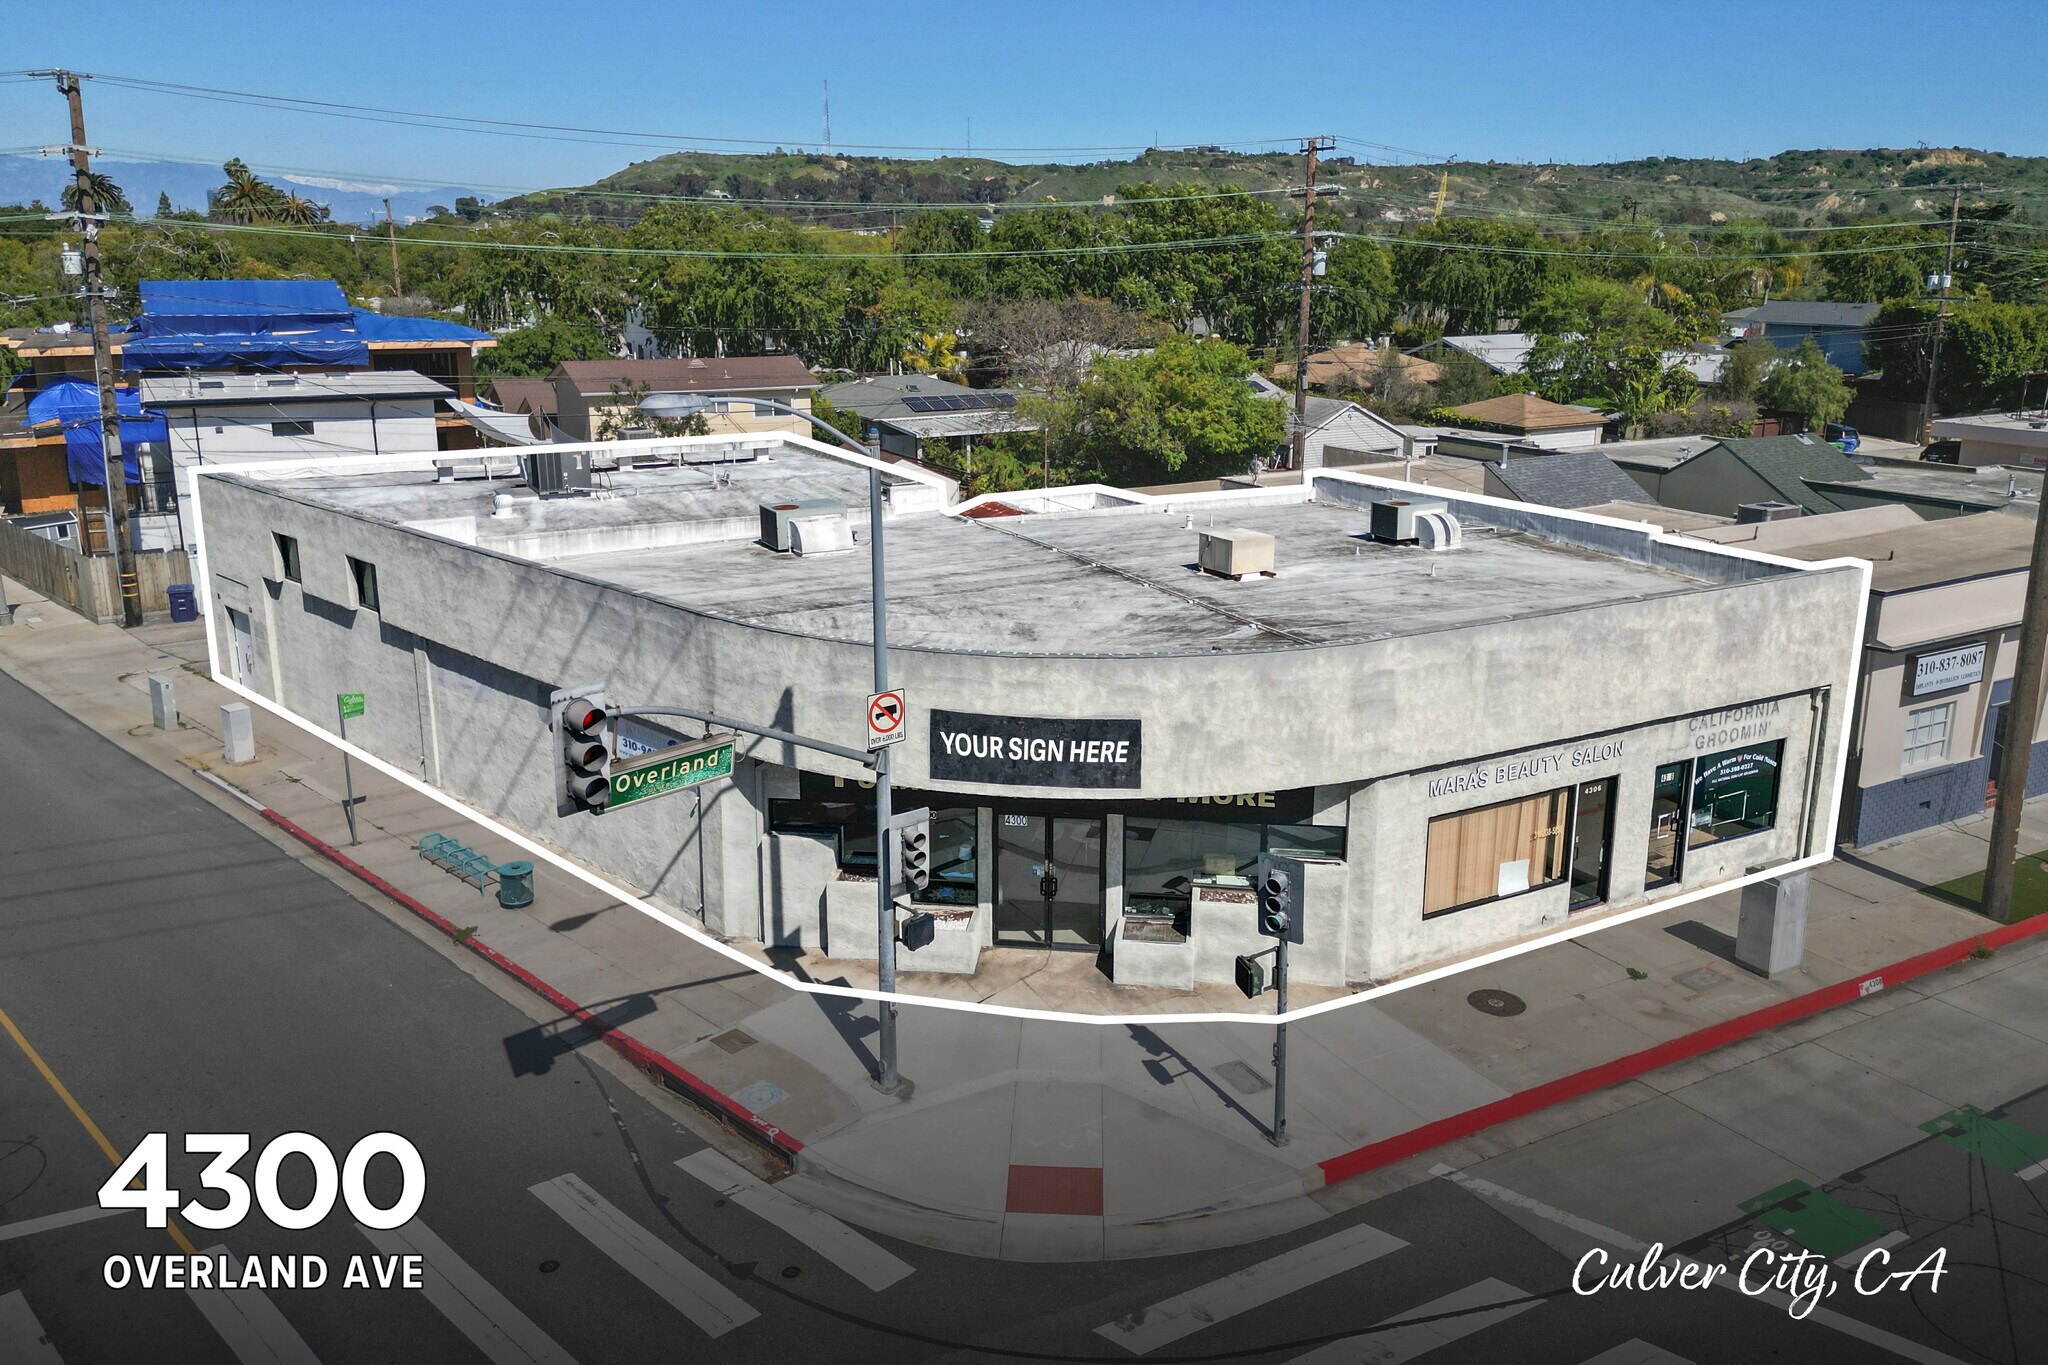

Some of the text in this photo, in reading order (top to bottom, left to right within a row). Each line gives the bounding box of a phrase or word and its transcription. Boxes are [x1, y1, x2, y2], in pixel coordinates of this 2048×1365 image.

[1918, 651, 1983, 677] 310-837-8087
[1688, 701, 1780, 732] CALIFORNIA
[940, 731, 1130, 763] YOUR SIGN HERE
[615, 749, 719, 793] Overland
[1428, 740, 1625, 797] MARA'S BEAUTY SALON
[1703, 767, 1716, 778] Have
[1721, 757, 1737, 767] Warm
[1752, 753, 1764, 762] Cold
[1584, 785, 1602, 794] 4306
[1005, 814, 1028, 827] 4300
